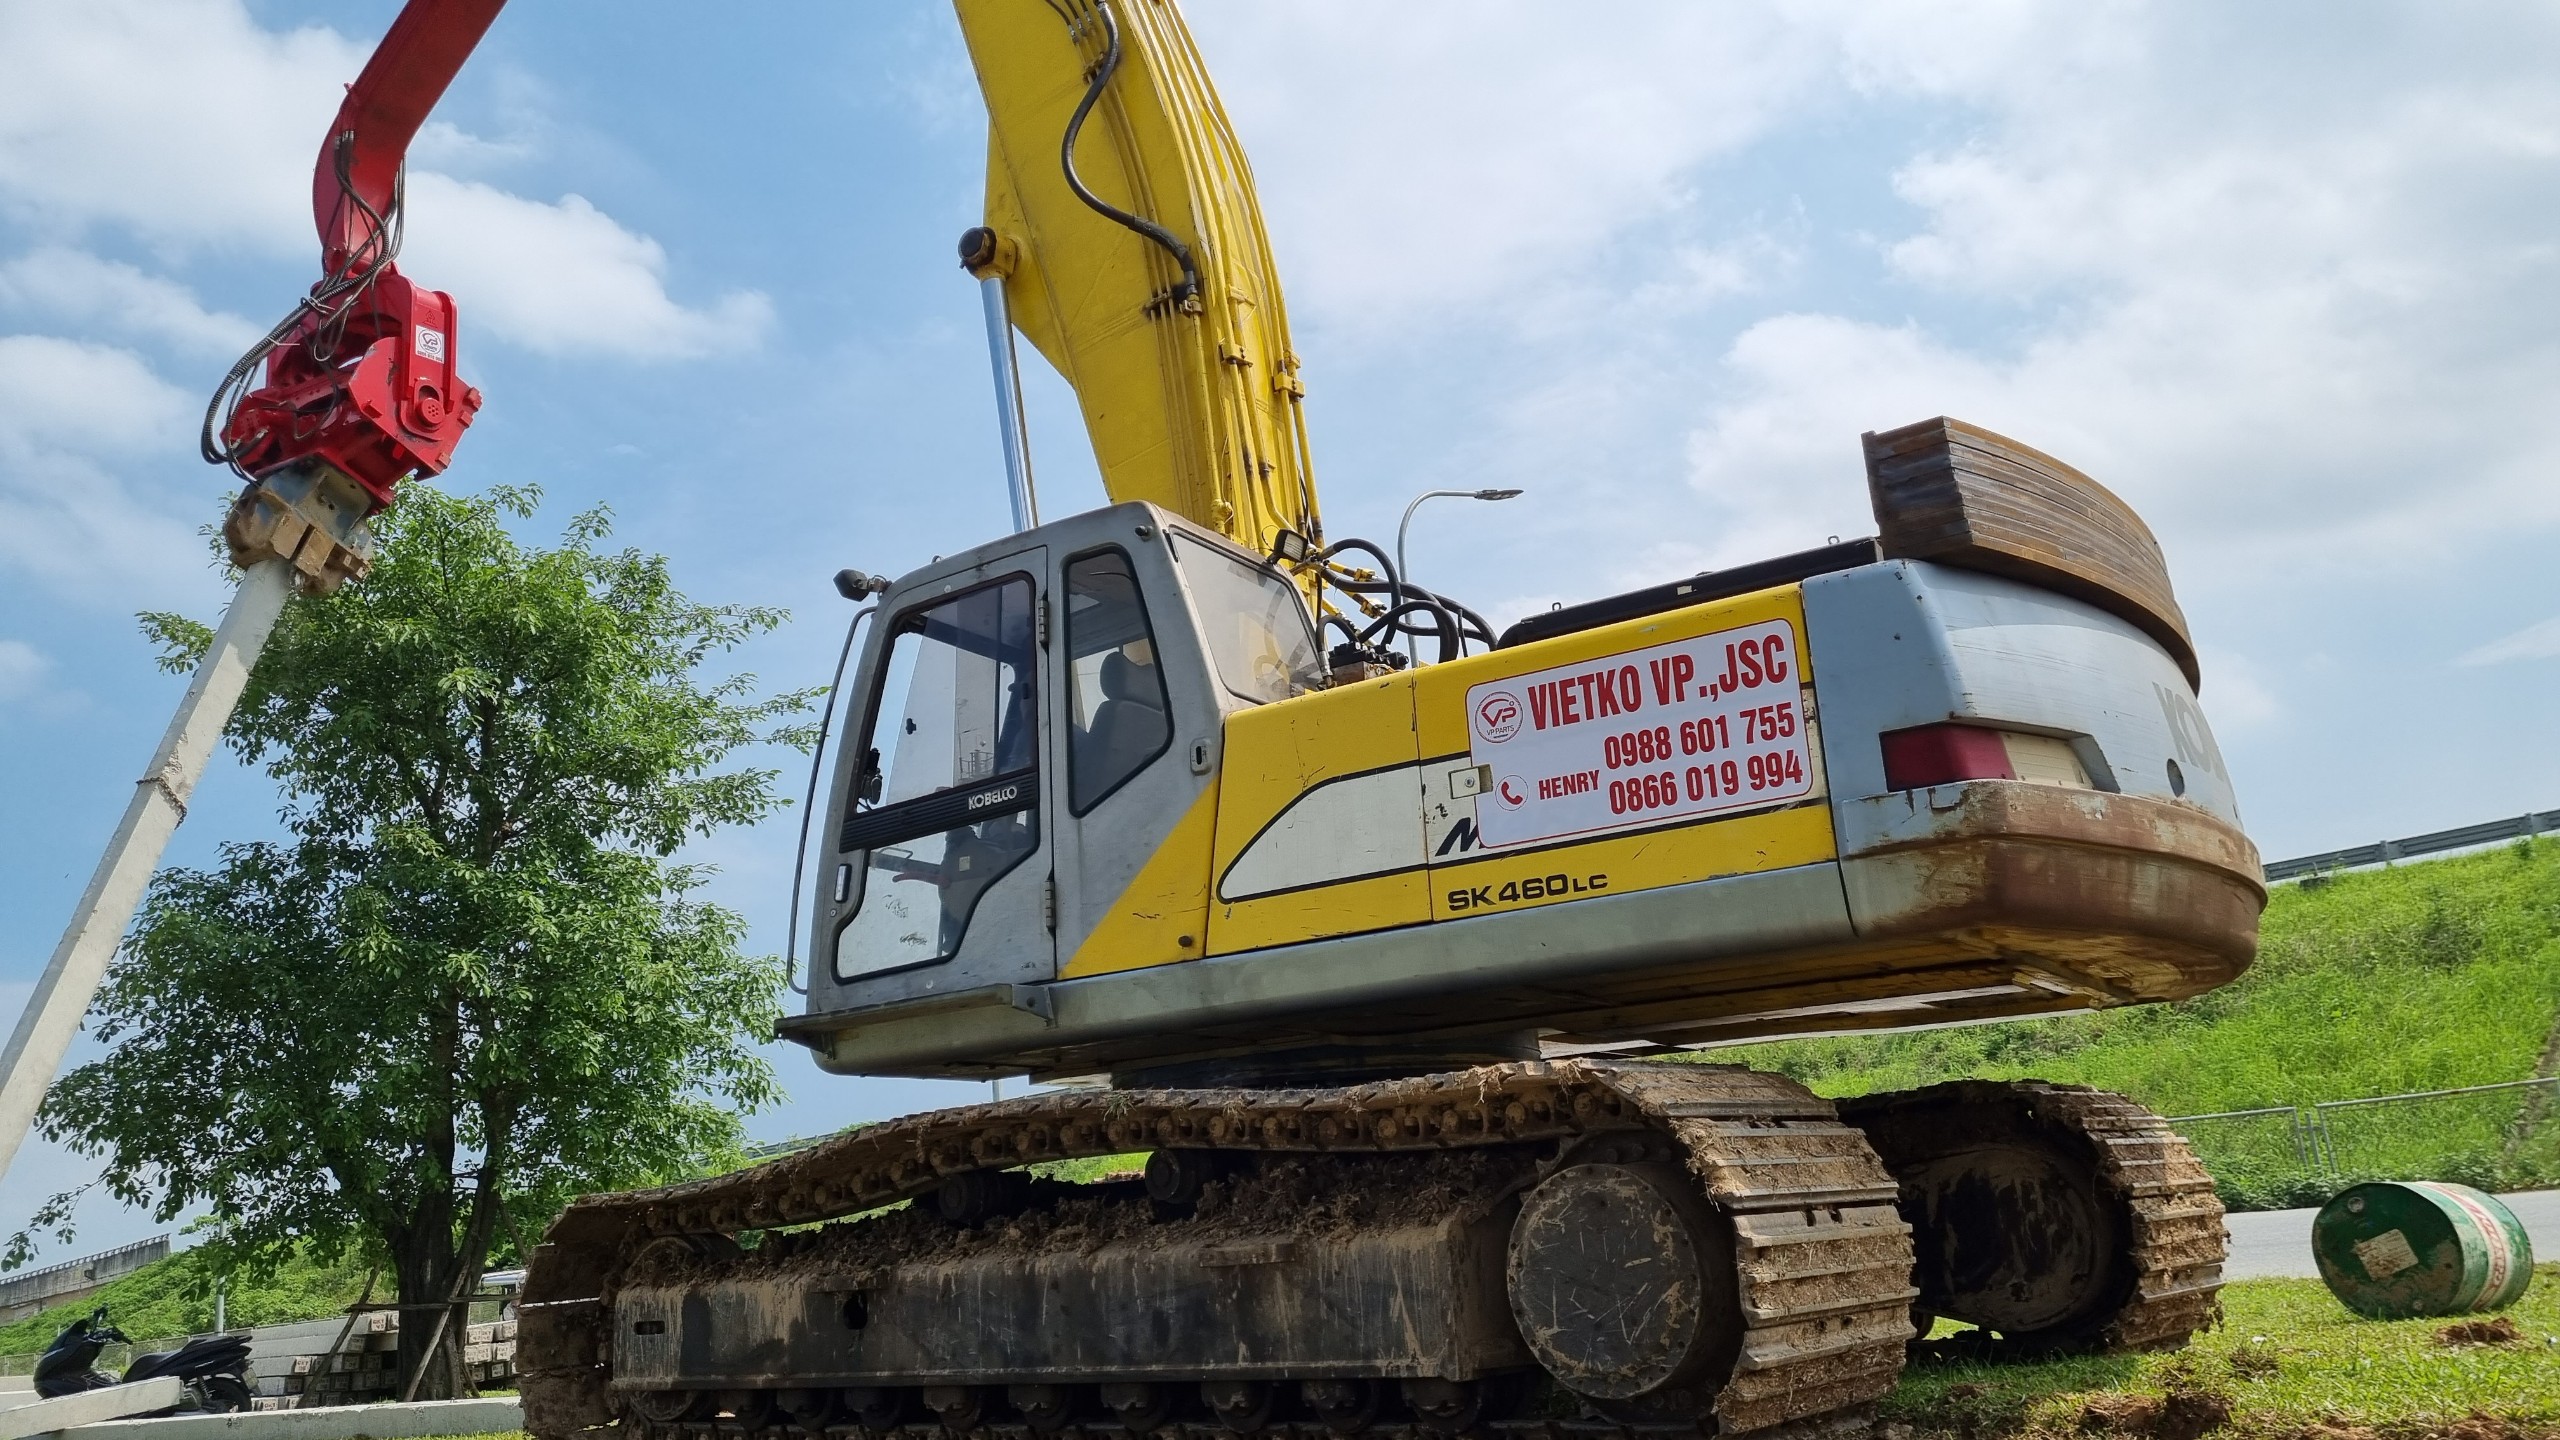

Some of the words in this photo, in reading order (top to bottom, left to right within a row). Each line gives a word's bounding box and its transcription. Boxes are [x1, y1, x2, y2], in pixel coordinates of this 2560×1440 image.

[1495, 725, 1515, 735] PARTS
[1528, 664, 1641, 731] VIETKO
[1604, 725, 1673, 770] 0988
[1681, 714, 1730, 756] 601
[1740, 702, 1796, 745] 755
[2152, 681, 2224, 782] KO
[968, 786, 1017, 810] KOBELCO
[1538, 769, 1600, 800] HENRY
[1608, 771, 1678, 815] 0866
[1685, 760, 1739, 802] 019
[1746, 750, 1803, 791] 994
